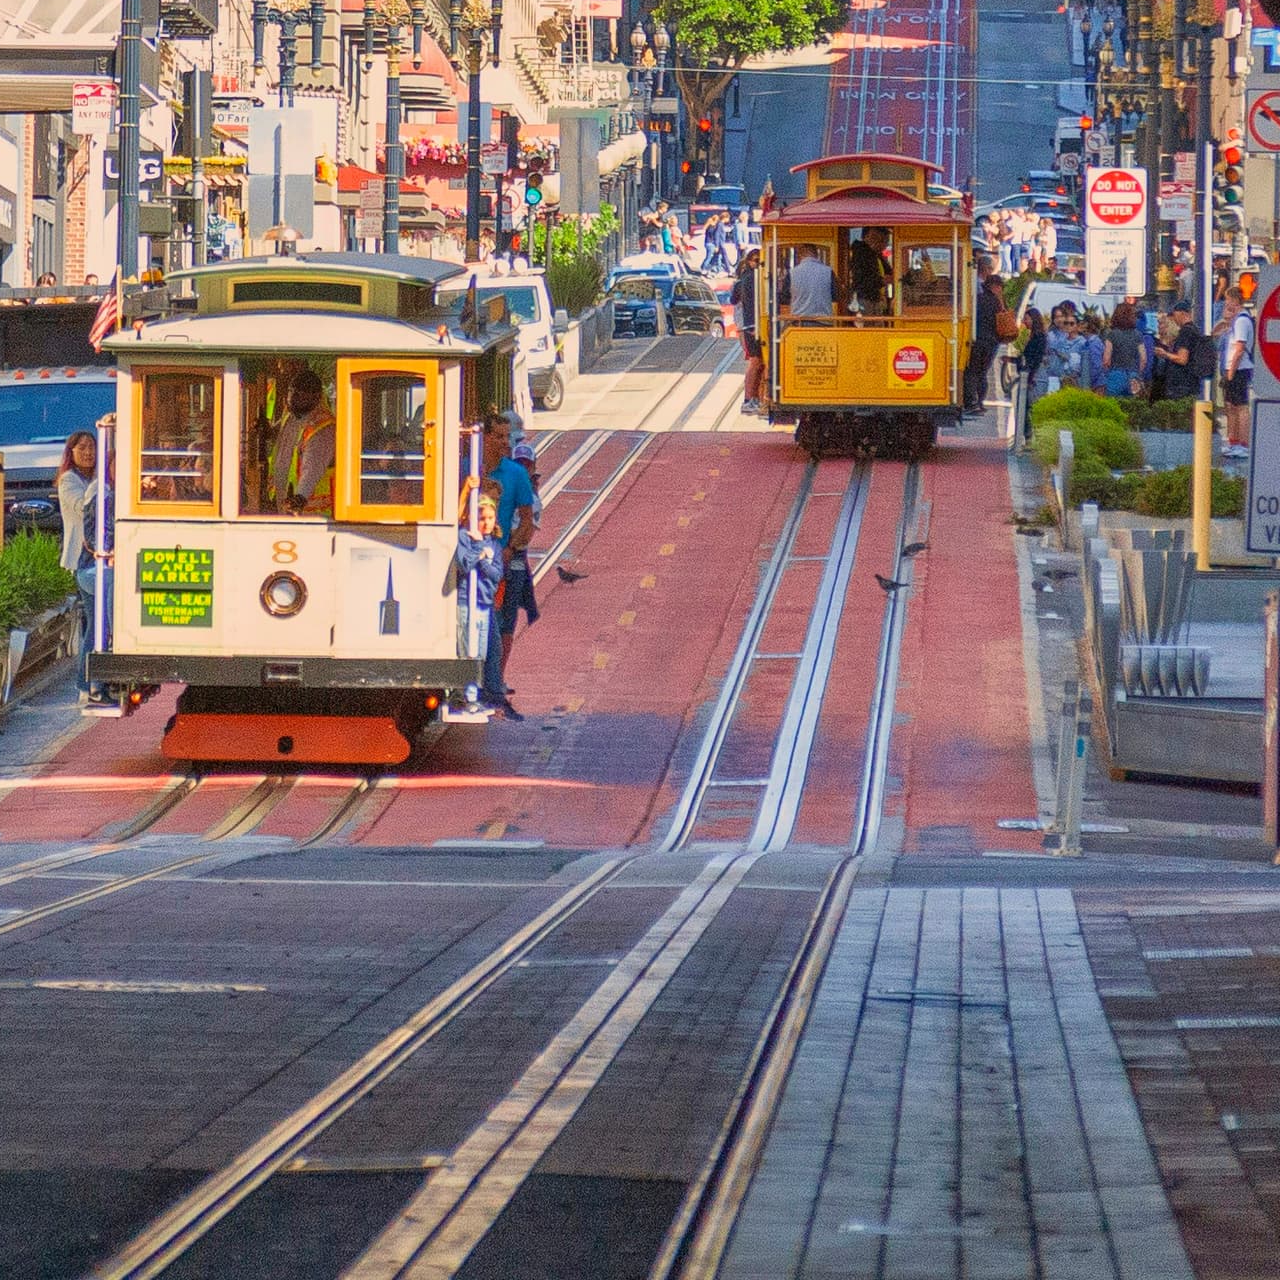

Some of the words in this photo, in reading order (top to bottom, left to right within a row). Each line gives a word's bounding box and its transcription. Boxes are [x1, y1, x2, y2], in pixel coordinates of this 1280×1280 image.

[78, 111, 92, 120] ANY
[95, 111, 111, 120] TIME
[1096, 180, 1113, 191] DO
[1116, 180, 1138, 192] NOT
[1099, 205, 1134, 217] ENTER
[143, 551, 212, 565] POWELL
[271, 540, 299, 564] 8
[161, 563, 195, 572] AND
[142, 571, 212, 583] MARKET
[181, 592, 212, 606] BEACH
[148, 607, 206, 617] FISHERMANS
[161, 616, 192, 625] WHARF
